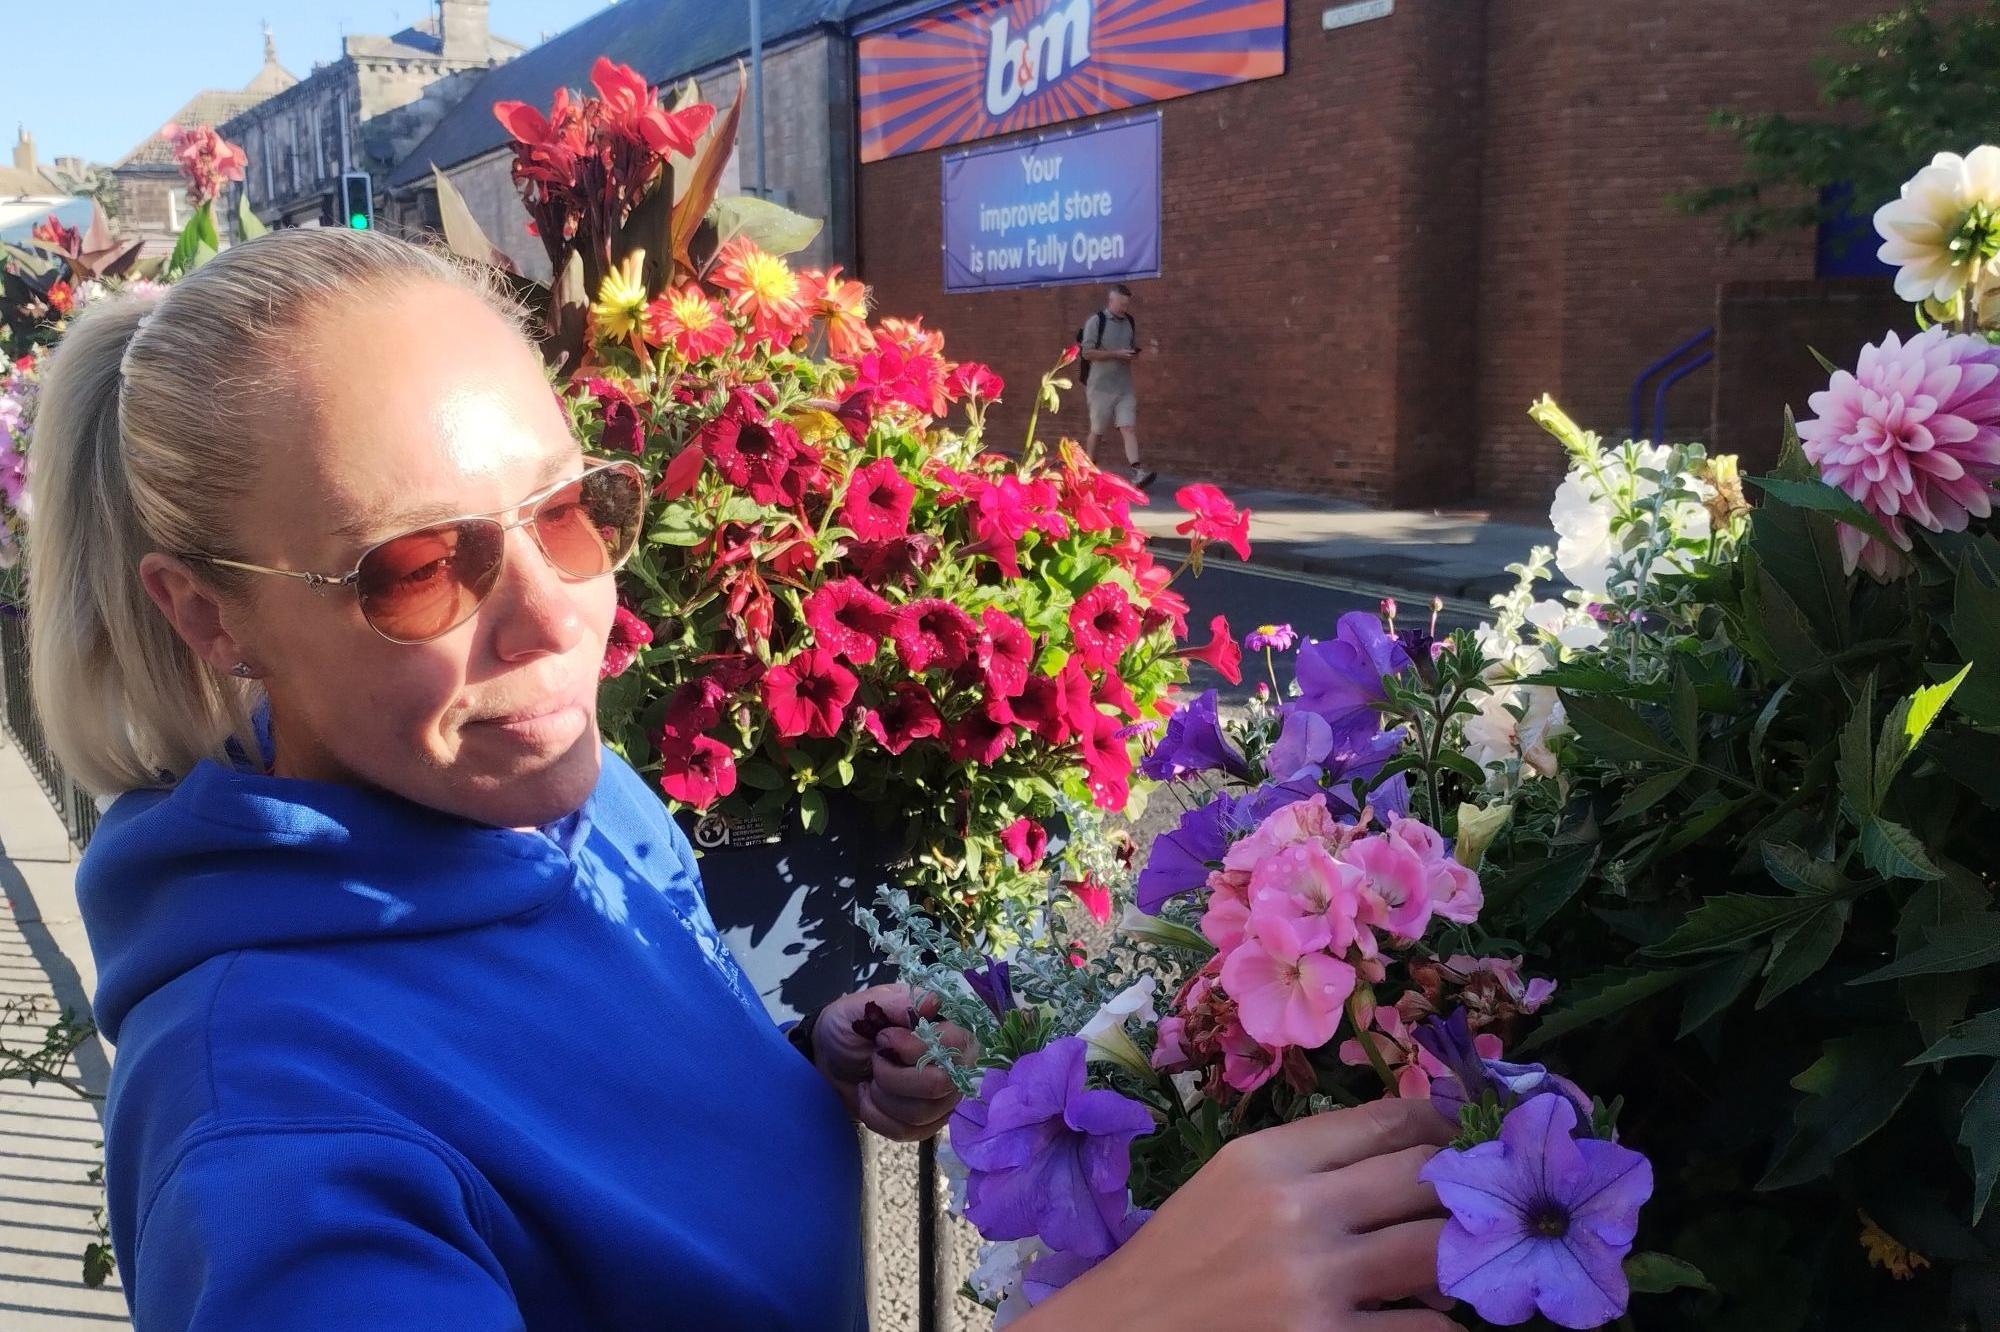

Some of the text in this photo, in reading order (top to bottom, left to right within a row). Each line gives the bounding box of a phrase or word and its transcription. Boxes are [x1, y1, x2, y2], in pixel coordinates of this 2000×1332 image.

[986, 0, 1091, 116] b&m
[1021, 155, 1063, 185] Your
[980, 190, 1112, 238] improved store
[970, 231, 1125, 274] is now Fully Open
